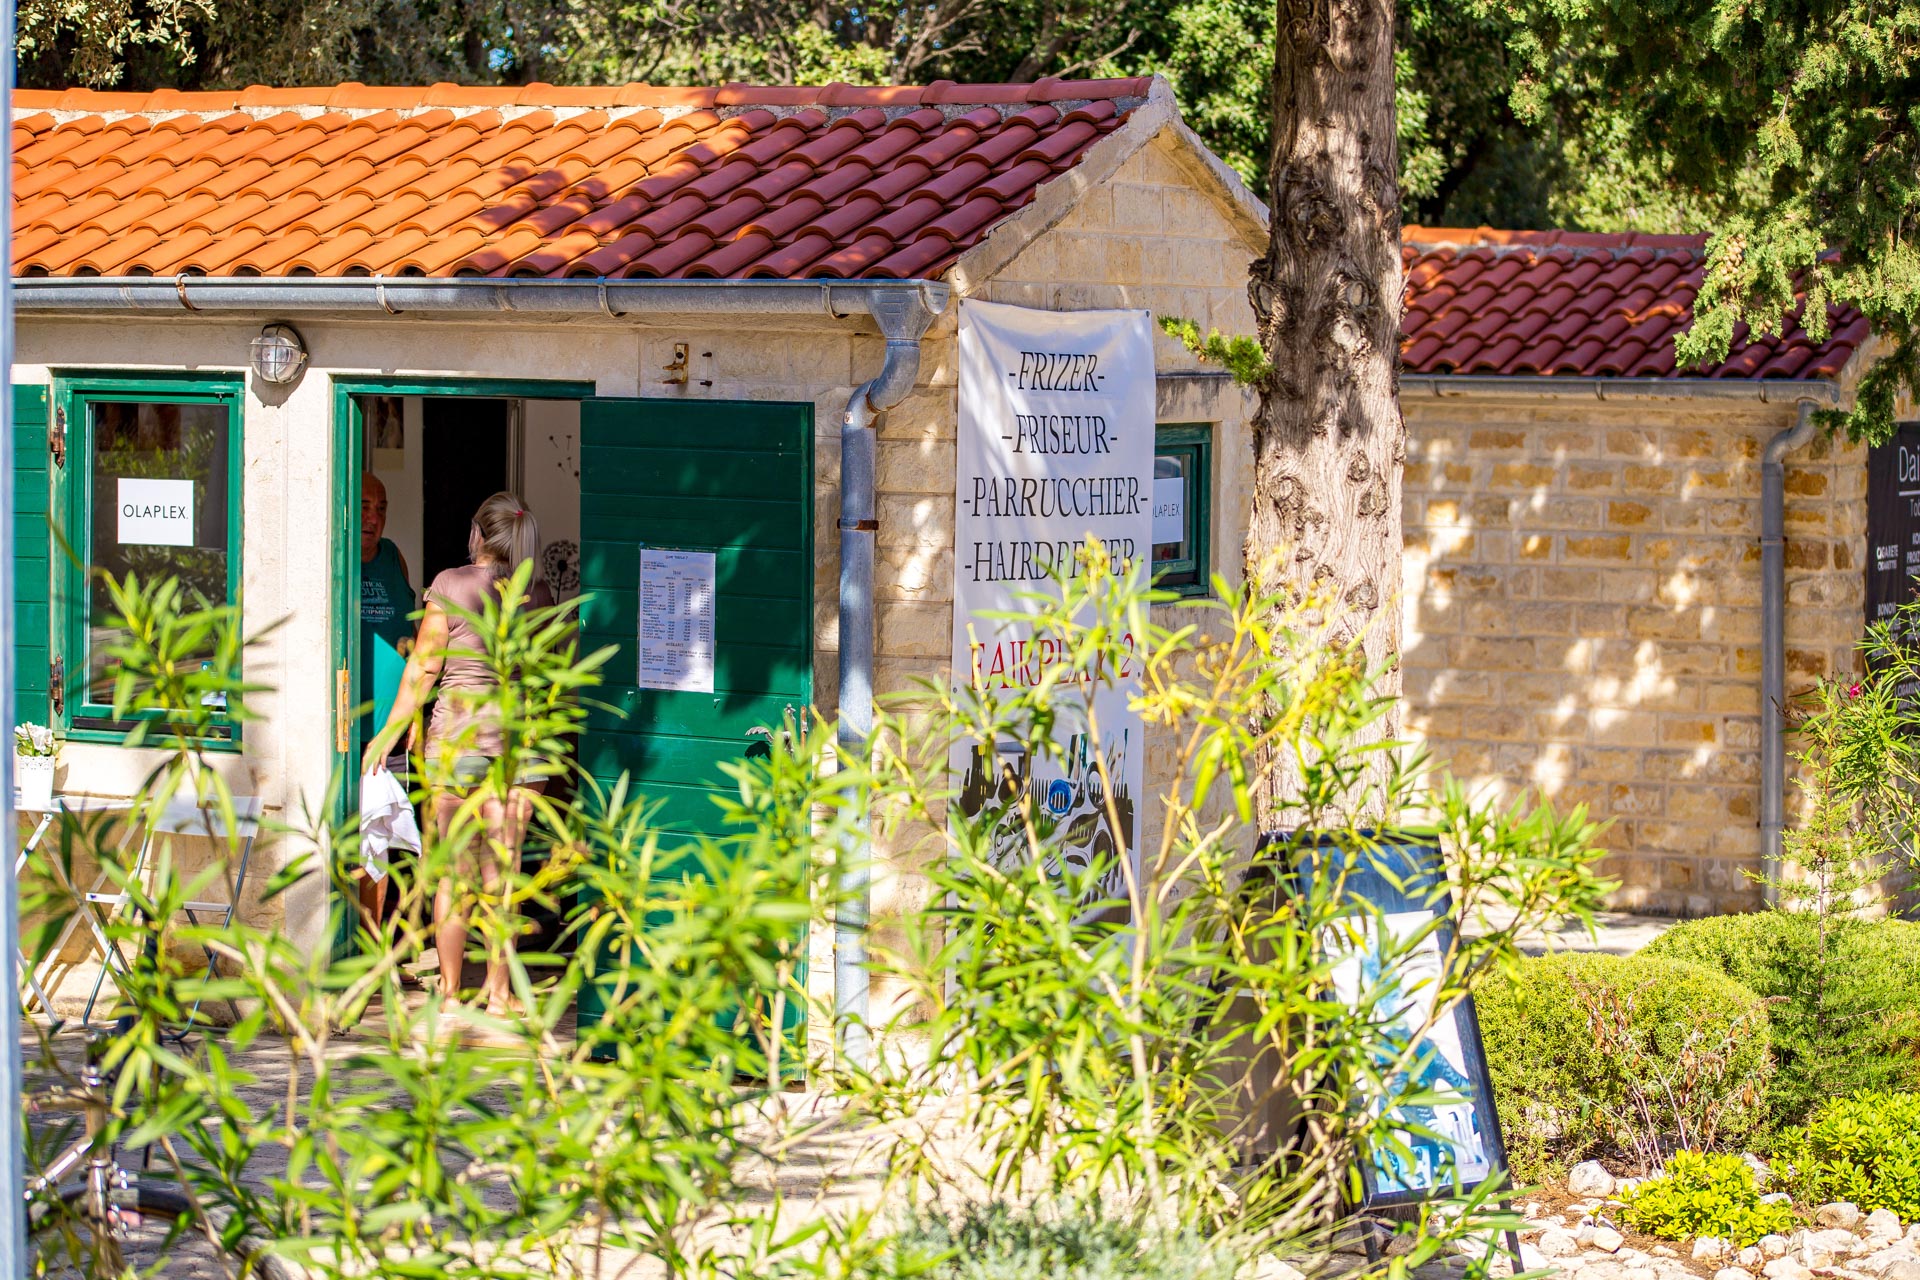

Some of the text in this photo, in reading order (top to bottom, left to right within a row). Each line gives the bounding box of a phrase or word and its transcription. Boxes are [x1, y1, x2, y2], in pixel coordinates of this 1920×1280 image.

[1008, 351, 1105, 392] -FRIZER-
[1001, 414, 1118, 455] -FRISEUR-
[963, 476, 1148, 518] -PARRUCCHIER-
[1152, 503, 1180, 518] LAPLEX
[964, 538, 1144, 582] -HAIRDREER-
[1117, 633, 1134, 679] 2
